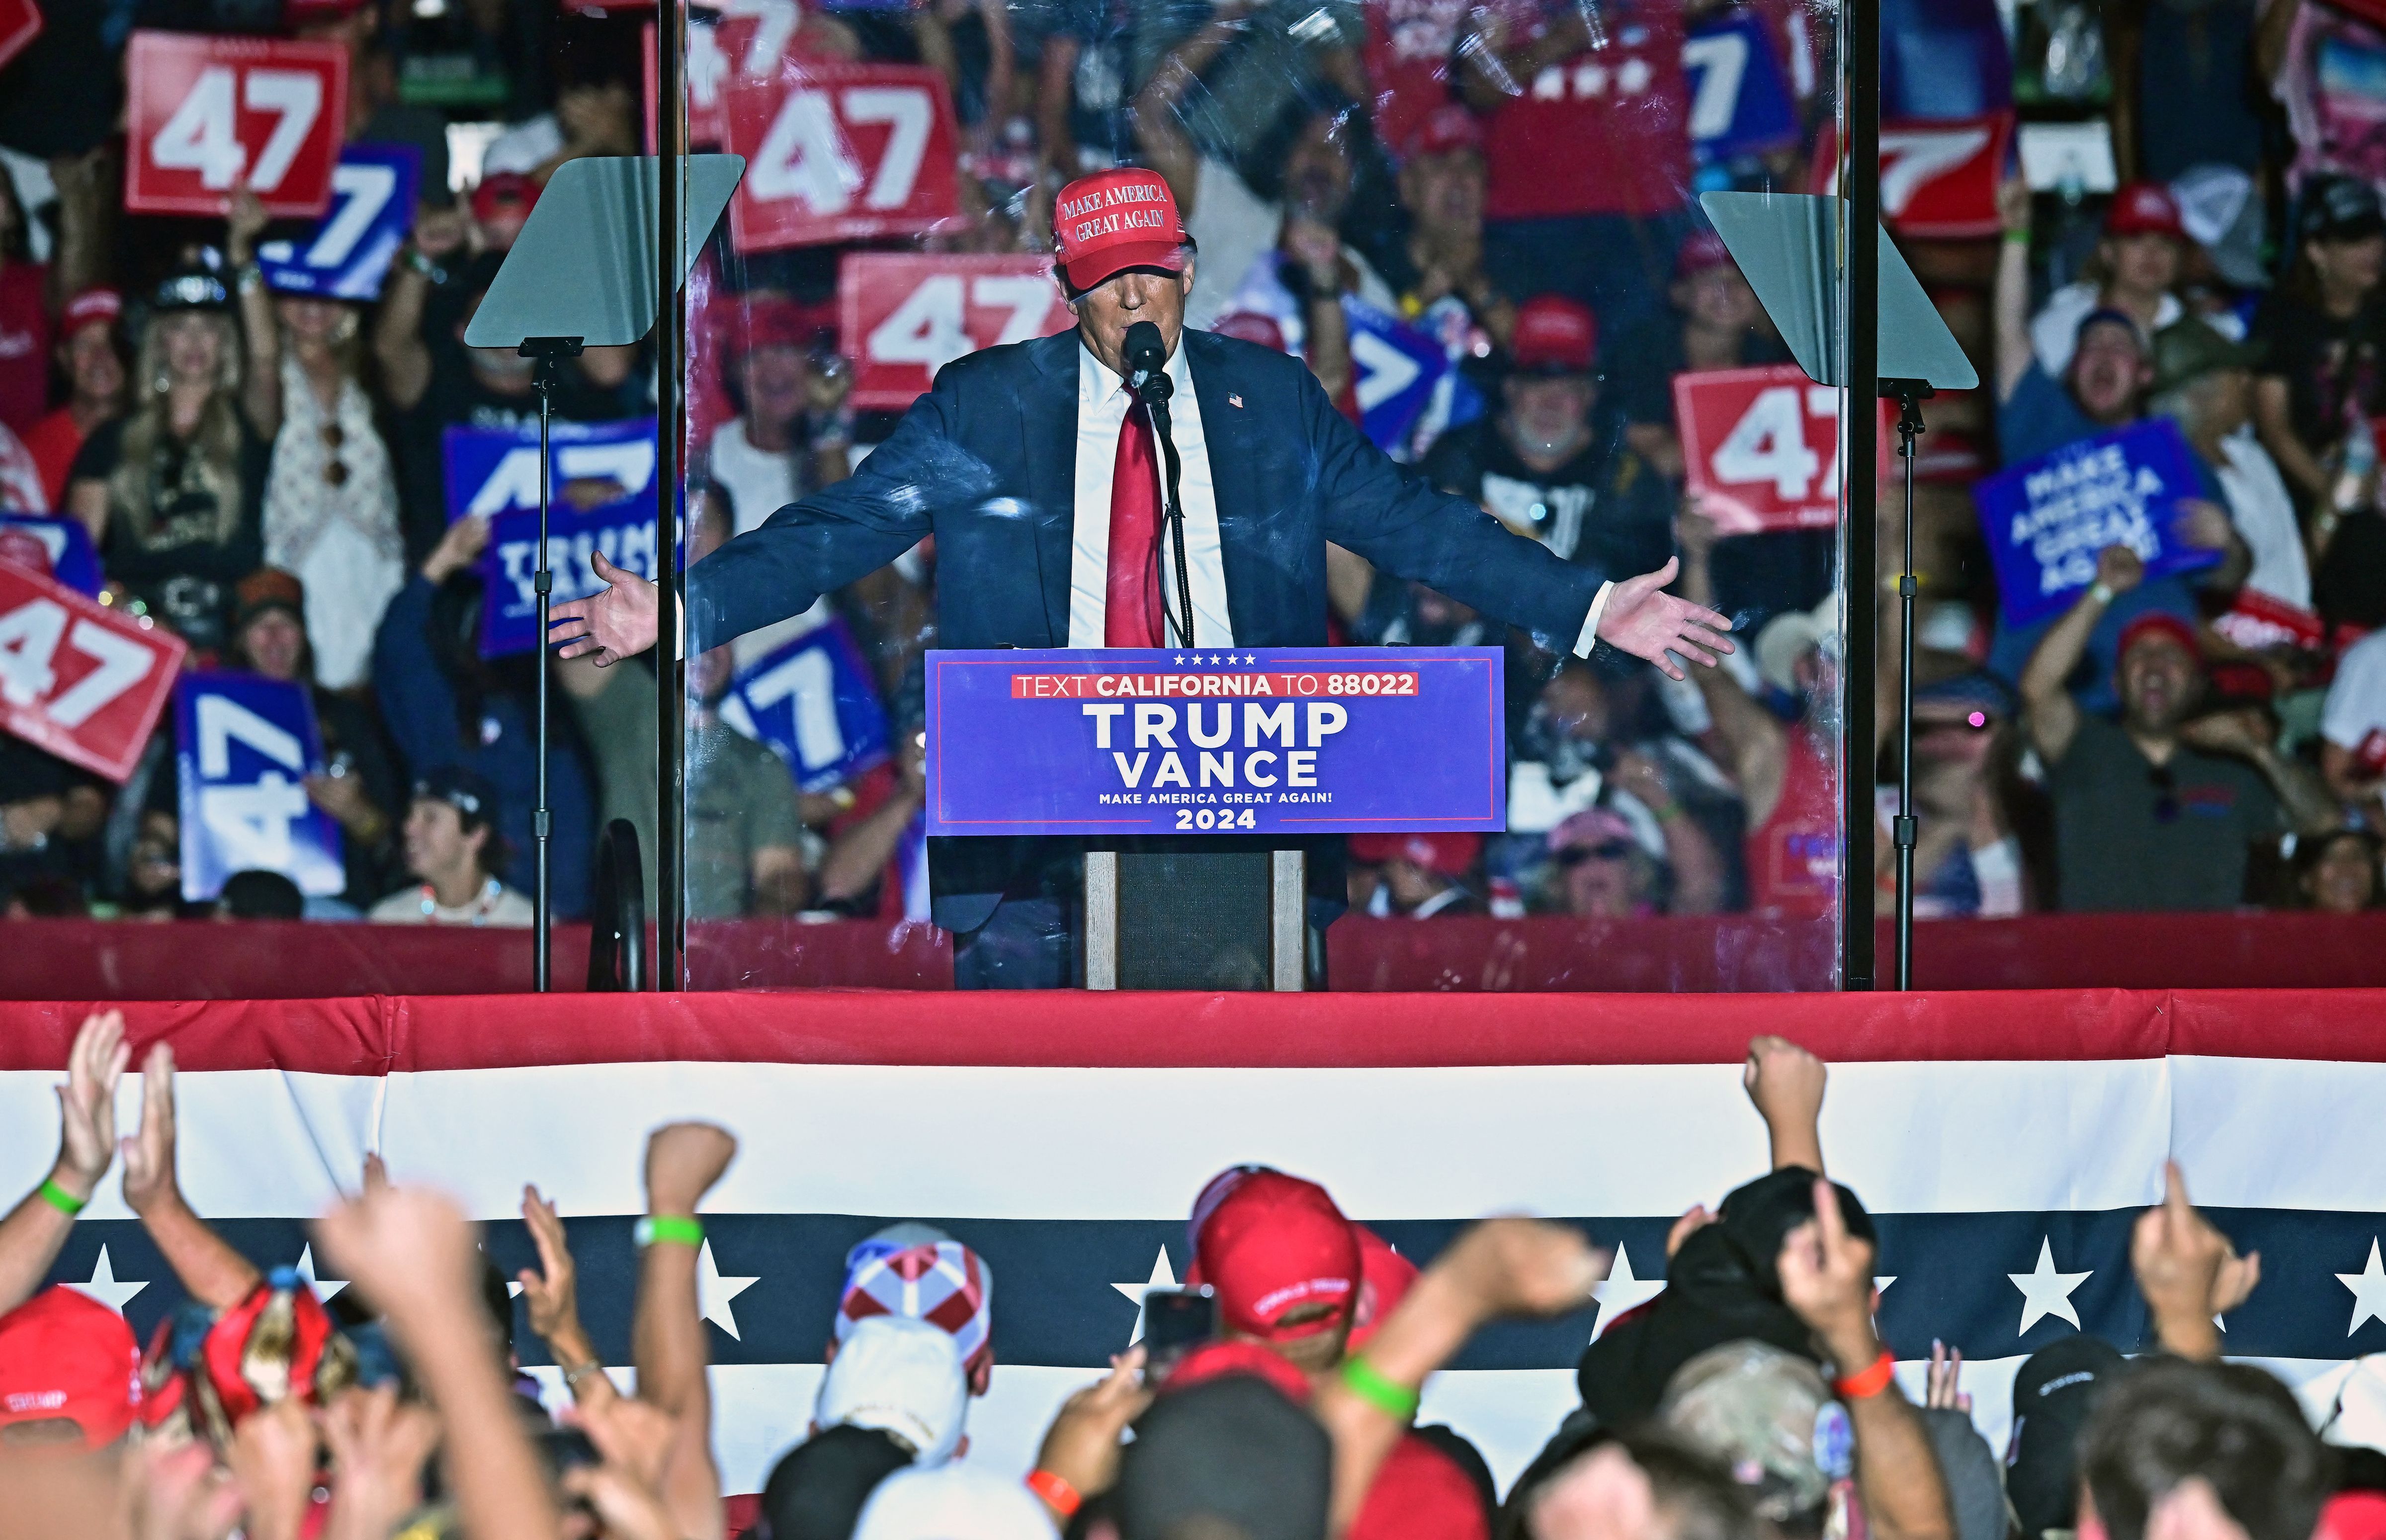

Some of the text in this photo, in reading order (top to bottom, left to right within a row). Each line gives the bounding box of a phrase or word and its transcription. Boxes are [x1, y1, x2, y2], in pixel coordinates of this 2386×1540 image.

[1686, 33, 1748, 139] 7
[152, 66, 323, 191] 47
[747, 87, 935, 215] 47
[1063, 184, 1168, 221] MAKE AMERICA
[1075, 214, 1119, 243] GREAT
[1124, 210, 1164, 229] AGAIN
[867, 274, 1054, 384] 47
[0, 597, 155, 727] 47
[1017, 674, 1414, 697] TEXT CALIFORNIA TO 88022
[1082, 701, 1348, 749] TRUMP
[1112, 750, 1317, 788] VANCE
[1100, 792, 1332, 804] MAKE AMERICA GREAT AGAIN!
[1176, 808, 1256, 830] 2024
